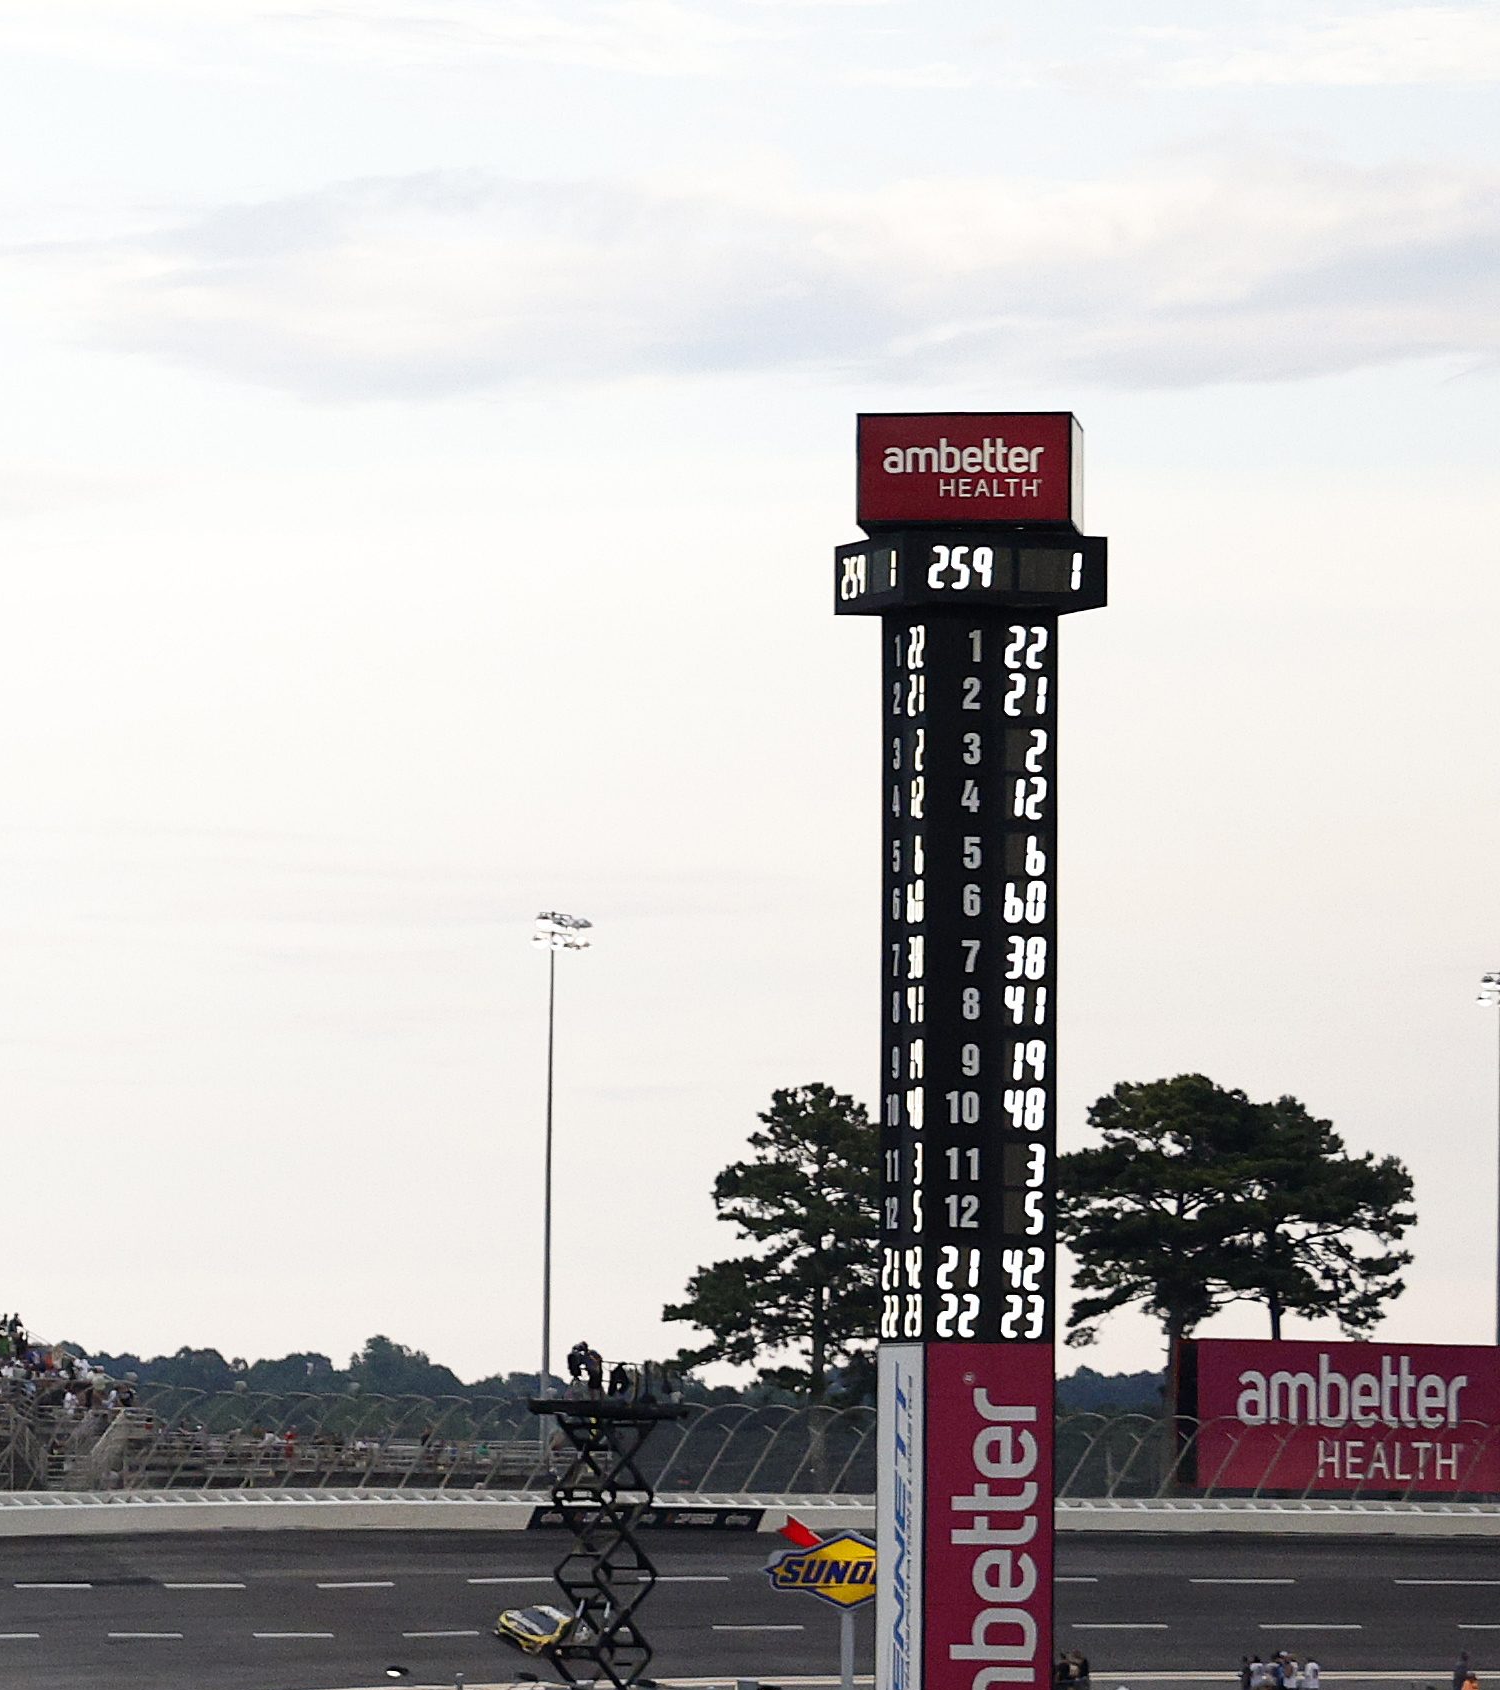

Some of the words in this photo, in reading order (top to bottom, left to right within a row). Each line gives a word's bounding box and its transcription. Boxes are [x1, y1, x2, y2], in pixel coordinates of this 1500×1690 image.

[884, 437, 1043, 474] ambetter
[939, 478, 1039, 497] HEALTH
[927, 545, 994, 590] 259
[1070, 552, 1083, 590] 1
[968, 630, 982, 663] 1
[1004, 626, 1048, 670] 22
[962, 677, 981, 710] 2
[1004, 673, 1048, 717] 21
[962, 733, 981, 764] 3
[1025, 729, 1048, 773] 2
[961, 780, 981, 813] 4
[1014, 777, 1047, 820] 12
[962, 837, 981, 869] 5
[1024, 835, 1046, 876] 6
[962, 885, 981, 916] 6
[1003, 881, 1047, 924] 60
[961, 940, 980, 973] 7
[1006, 935, 1046, 979] 38
[962, 988, 980, 1020] 8
[1005, 986, 1045, 1025] 41
[962, 1043, 980, 1077] 9
[1012, 1039, 1046, 1082] 19
[945, 1091, 980, 1124] 10
[1004, 1087, 1046, 1131] 48
[945, 1147, 980, 1180] 11
[1026, 1143, 1045, 1187] 3
[944, 1195, 980, 1228] 12
[1025, 1191, 1044, 1235] 5
[937, 1246, 980, 1290] 21
[1002, 1247, 1044, 1291] 42
[936, 1294, 980, 1339] 22
[1001, 1294, 1044, 1339] 23
[1236, 1353, 1467, 1429] ambetter
[1317, 1441, 1458, 1481] HEALTH
[779, 1560, 875, 1585] SUNO
